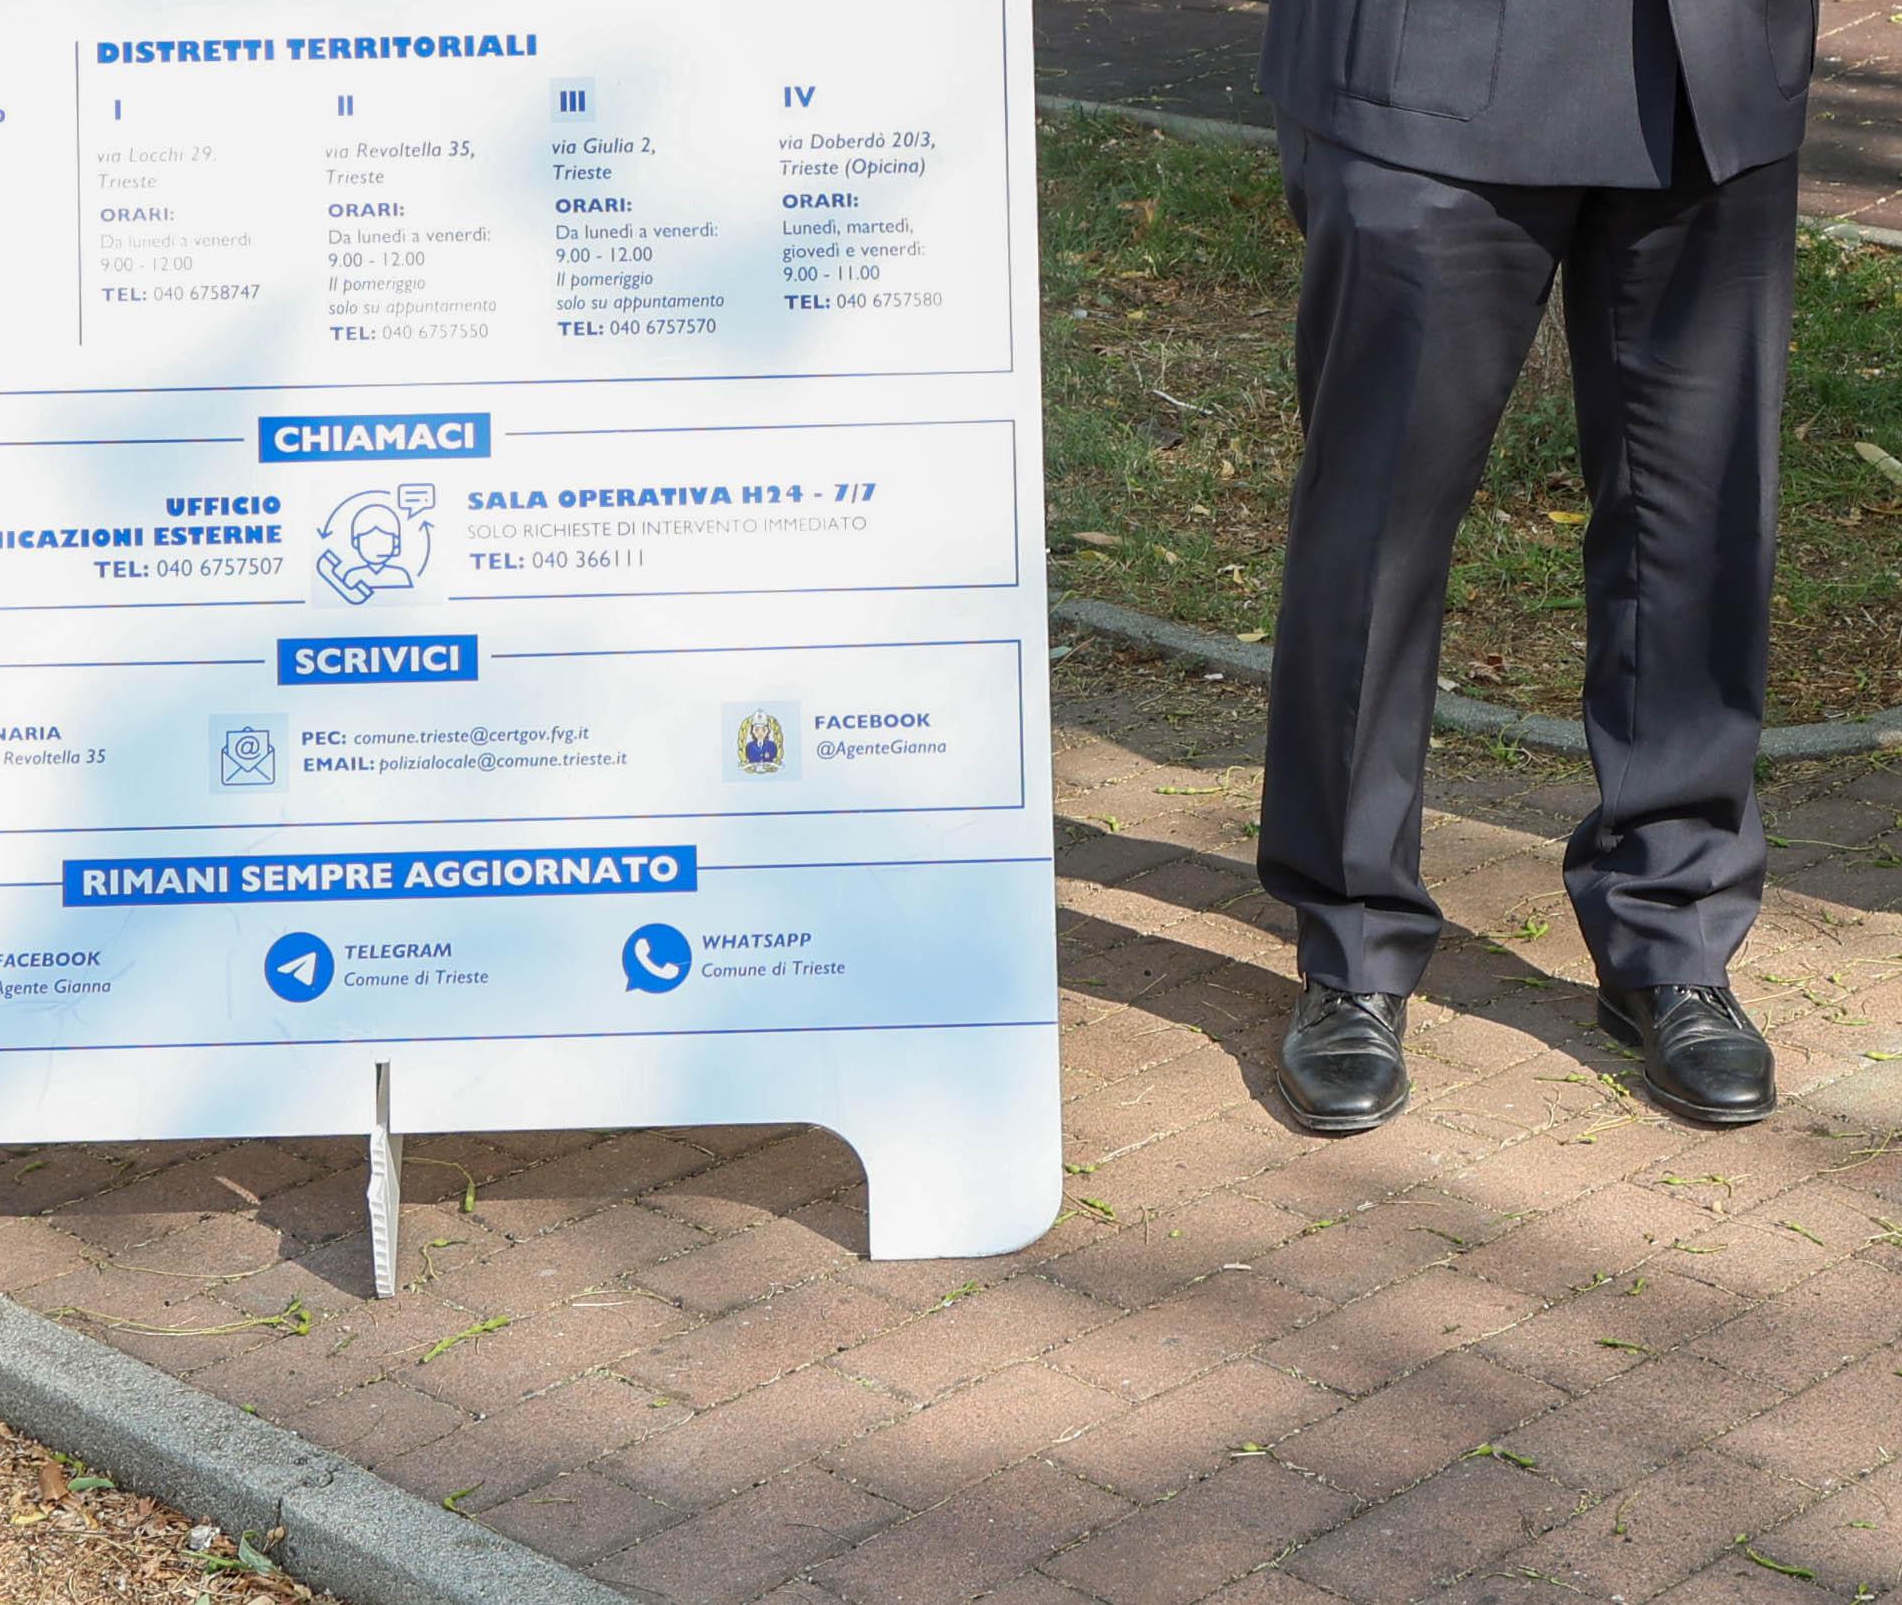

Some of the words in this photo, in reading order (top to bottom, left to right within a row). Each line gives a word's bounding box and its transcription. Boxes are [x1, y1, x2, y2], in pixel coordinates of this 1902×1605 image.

[98, 39, 274, 64] DISTRETTI
[287, 34, 537, 63] TERRITORIALI
[560, 91, 585, 111] III
[784, 86, 815, 107] IV
[115, 100, 121, 120] I
[338, 95, 353, 116] II
[552, 140, 576, 154] via
[583, 138, 634, 154] Giulia
[641, 138, 655, 155] 2,
[779, 135, 803, 149] via
[811, 133, 885, 149] Doberdò
[893, 131, 935, 149] 20/3,
[325, 145, 349, 159] via
[356, 142, 441, 158] Revoltella
[448, 141, 475, 159] 35,
[553, 165, 612, 180] Trieste
[780, 160, 838, 175] Trieste
[846, 157, 925, 178] (Opicina)
[326, 170, 384, 184] Trieste
[556, 198, 631, 213] ORARI:
[783, 194, 858, 208] ORARI:
[100, 207, 175, 221] ORARI:
[329, 203, 405, 218] ORARI:
[556, 225, 578, 240] Da
[585, 224, 633, 239] lunedì
[639, 228, 647, 238] a
[654, 223, 718, 237] venerdì:
[783, 219, 840, 235] Lunedì,
[847, 218, 913, 234] martedì,
[329, 230, 351, 244] Da
[412, 233, 419, 242] a
[329, 253, 362, 268] 9.00
[383, 251, 425, 266] 12.00
[556, 248, 590, 262] 9.00
[611, 247, 653, 262] 12.00
[783, 243, 839, 263] giovedì
[846, 247, 854, 257] e
[571, 272, 653, 290] pomeriggio
[784, 267, 817, 282] 9.00
[839, 266, 880, 280] 11.00
[102, 288, 146, 301] TEL:
[154, 286, 183, 300] 040
[190, 285, 260, 300] 6758747
[343, 278, 425, 294] pomeriggio
[329, 300, 358, 314] solo
[364, 304, 380, 314] su
[386, 300, 496, 317] appuntamento
[557, 295, 585, 310] solo
[591, 299, 607, 309] su
[614, 295, 724, 312] appuntamento
[784, 295, 830, 309] TEL:
[837, 294, 866, 308] 040
[873, 292, 942, 307] 6757580
[330, 327, 376, 340] TEL:
[383, 325, 412, 339] 040
[558, 322, 603, 336] TEL:
[610, 320, 640, 335] 040
[646, 319, 716, 334] 6757570
[274, 423, 475, 453] CHIAMACI
[468, 491, 548, 510] SALA
[558, 486, 732, 508] OPERATIVA
[742, 485, 804, 505] H24
[834, 482, 877, 503] 7/7
[167, 496, 280, 516] UFFICIO
[154, 525, 282, 546] ESTERNE
[468, 522, 517, 539] SOLO
[524, 520, 612, 538] RICHIESTE
[617, 520, 635, 536] DI
[642, 518, 759, 536] INTERVENTO
[764, 515, 867, 533] IMMEDIATO
[94, 561, 149, 578] TEL:
[157, 559, 192, 578] 040
[200, 558, 283, 576] 6757507
[470, 553, 524, 570] TEL:
[533, 551, 567, 569] 040
[576, 549, 644, 568] 366111
[295, 646, 459, 676] SCRIVICI
[815, 713, 930, 729] FACEBOOK
[302, 731, 346, 745] PEC:
[354, 726, 589, 746] comune.trieste@certgov.fvg.it
[4, 750, 80, 766] Revoltella
[86, 749, 105, 764] 35
[816, 739, 946, 759] @AgenteGianna
[304, 758, 374, 772] EMAIL:
[379, 752, 627, 775] polizialocale@comune.trieste.it
[83, 867, 228, 895] RIMANI
[242, 863, 392, 892] SEMPRE
[404, 855, 678, 889] AGGIORNATO
[702, 933, 811, 949] WHATSAPP
[345, 943, 452, 960] TELEGRAM
[702, 962, 768, 978] Comune
[773, 960, 788, 977] di
[792, 959, 845, 976] Trieste
[53, 979, 111, 994] Gianna
[344, 971, 408, 988] Comune
[414, 969, 430, 986] di
[436, 969, 489, 985] Trieste
